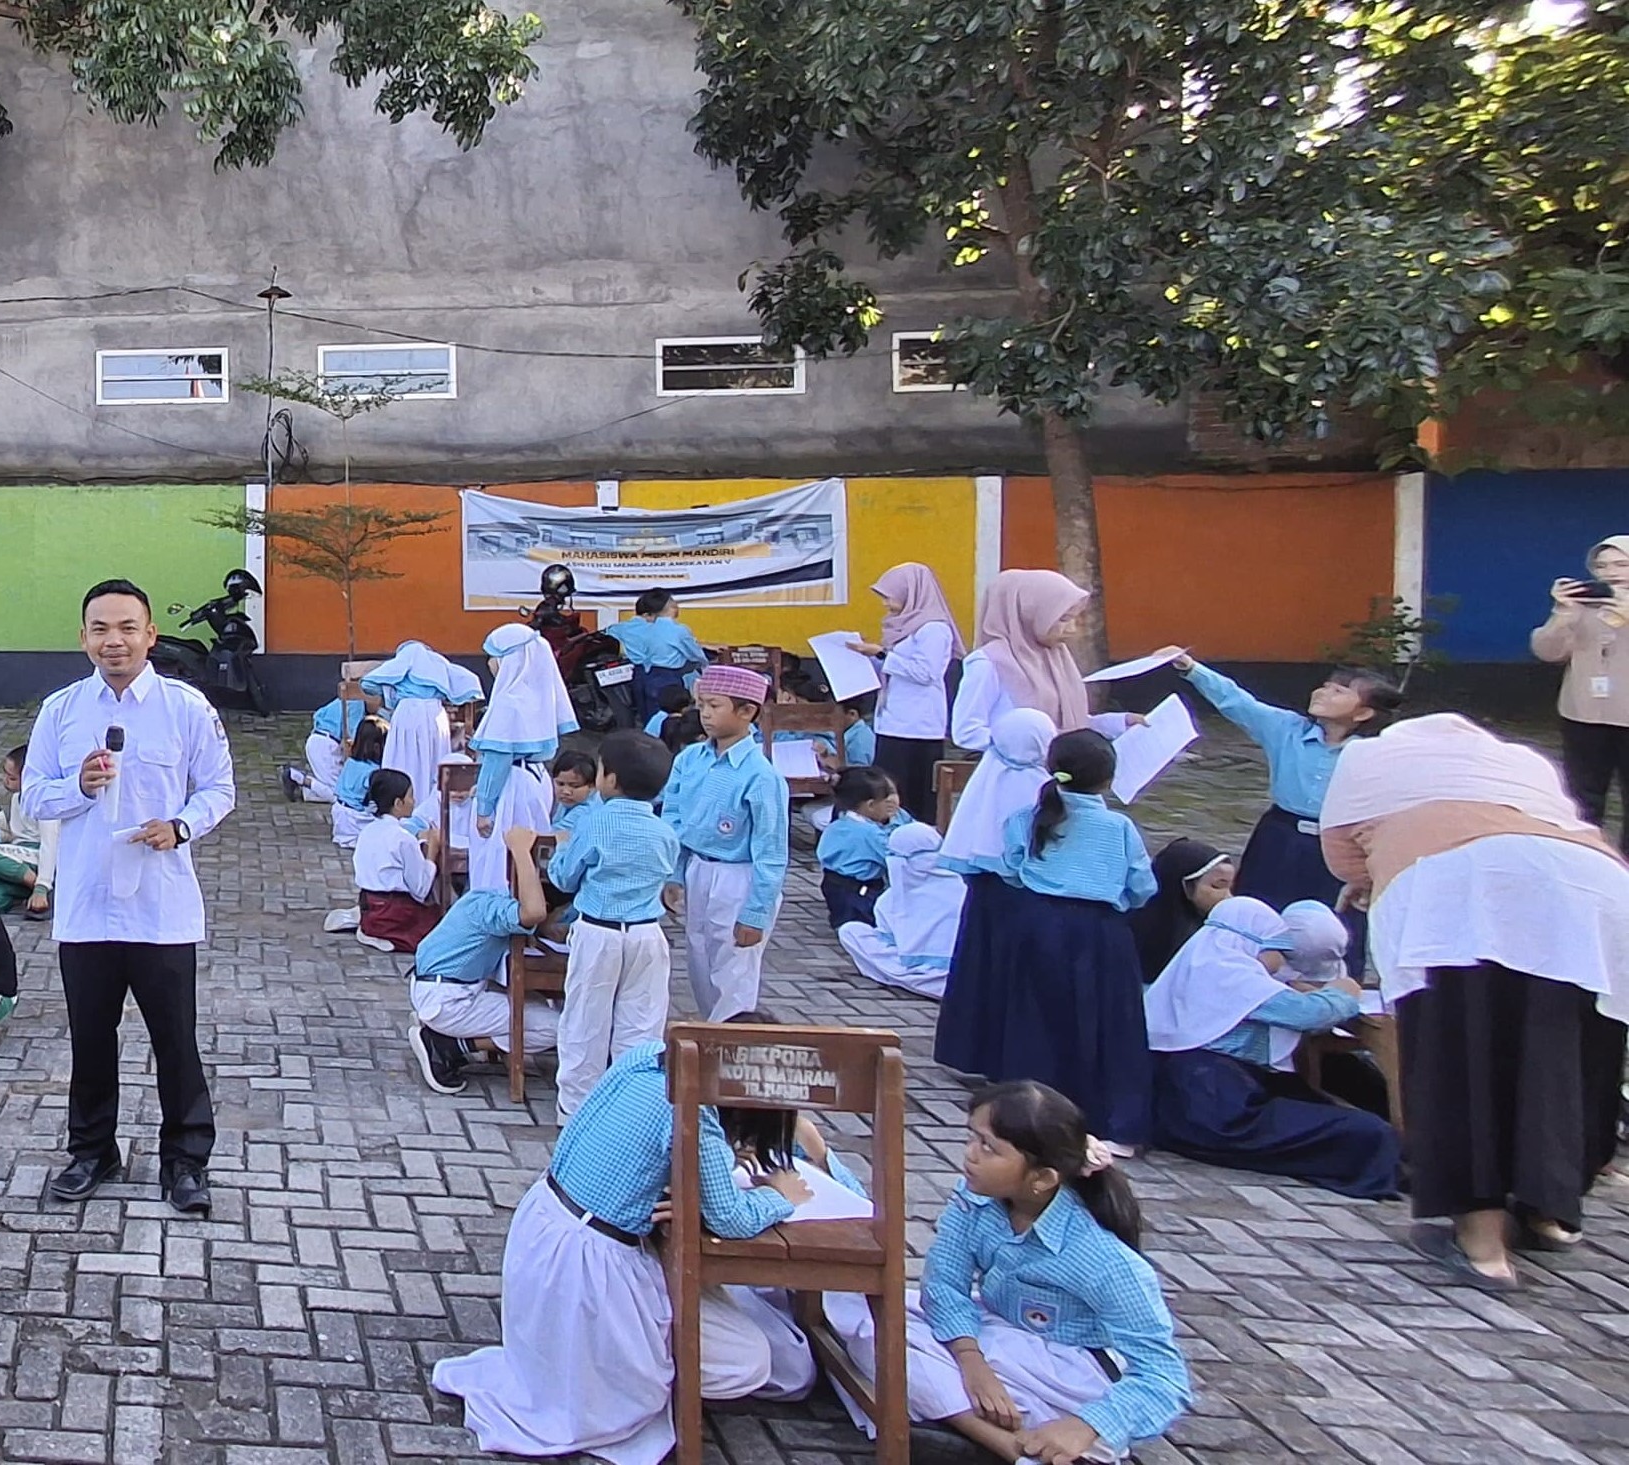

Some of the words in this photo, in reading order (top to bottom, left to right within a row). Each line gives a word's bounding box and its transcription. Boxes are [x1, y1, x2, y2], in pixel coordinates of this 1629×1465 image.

[561, 551, 638, 559] MAHASISWA
[682, 548, 735, 557] MANDIRI
[764, 1065, 837, 1088] MATARAM
